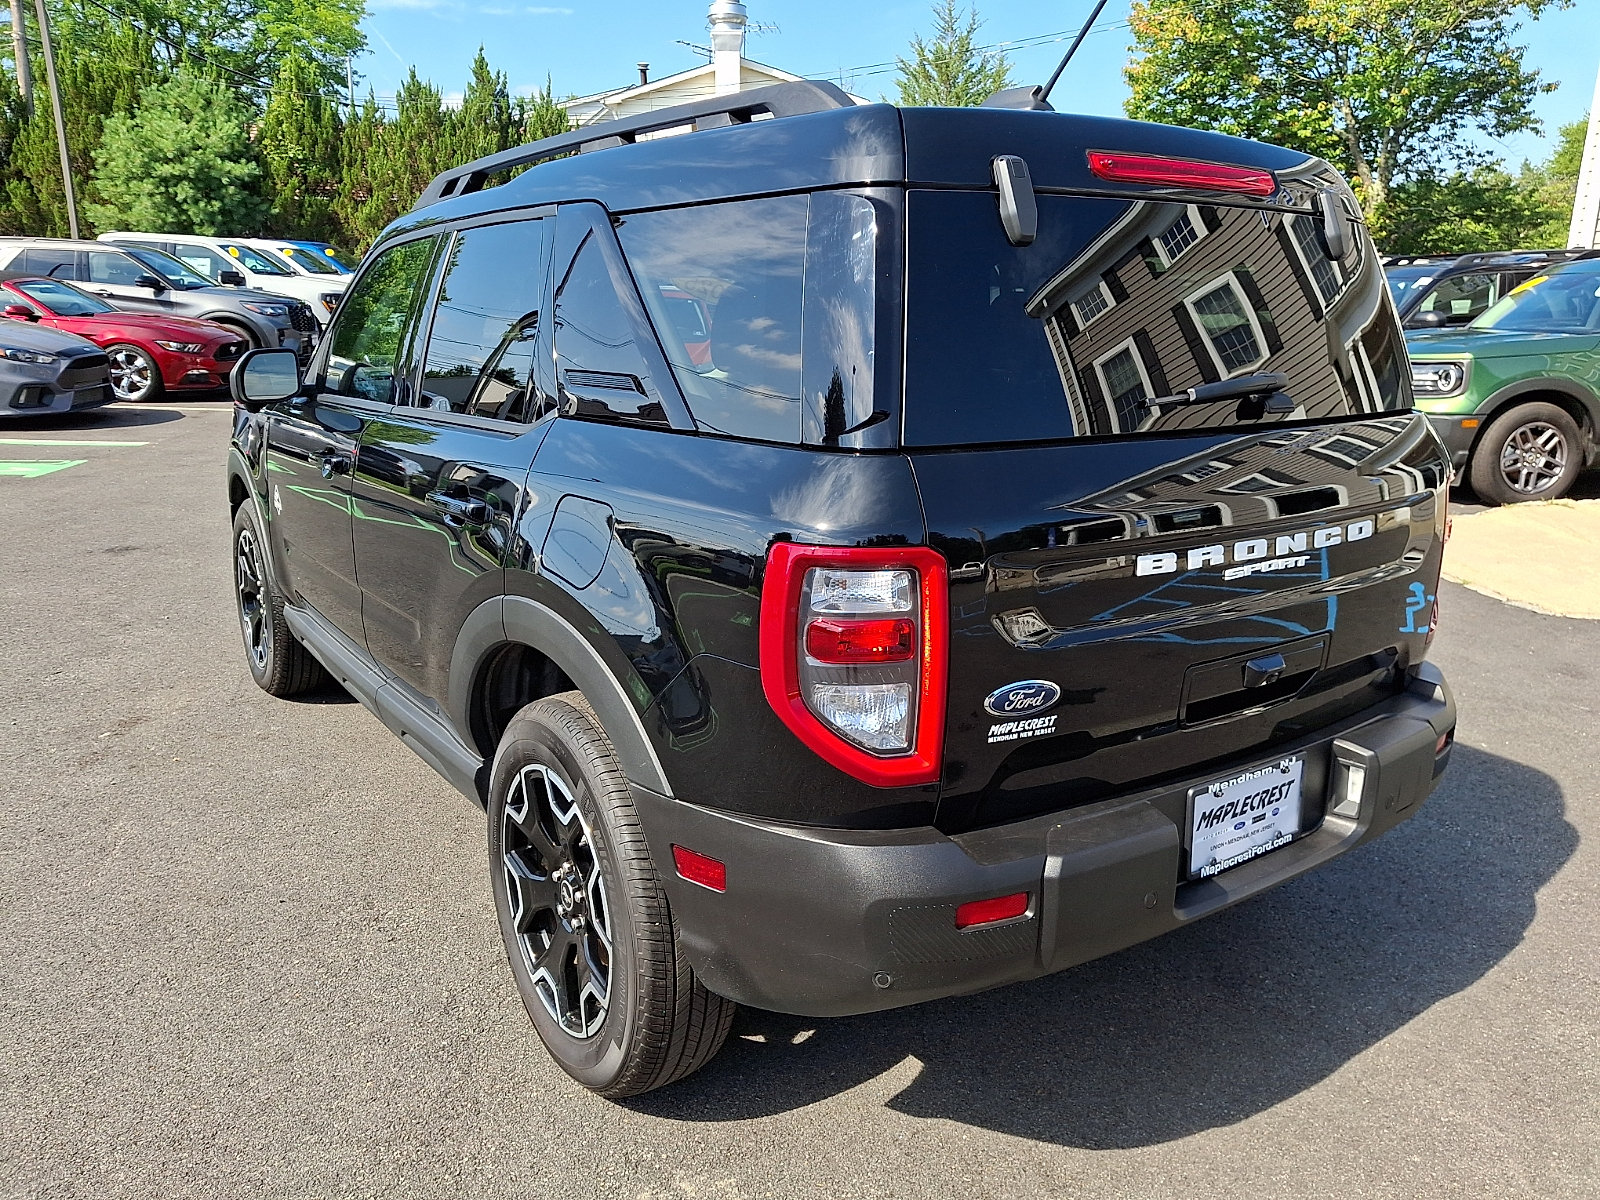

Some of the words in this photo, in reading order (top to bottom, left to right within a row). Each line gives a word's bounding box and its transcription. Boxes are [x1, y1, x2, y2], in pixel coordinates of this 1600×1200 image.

[1136, 519, 1373, 577] BRONCO
[1221, 555, 1310, 581] SPORT
[1004, 688, 1046, 711] Ford
[988, 715, 1058, 736] MAPLECREST
[988, 733, 1018, 743] MENDHAM
[1034, 727, 1056, 736] JERSEY
[1208, 766, 1278, 793] Mendham,
[1279, 756, 1297, 769] NJ
[1196, 779, 1295, 831] MAPLECREST
[1200, 833, 1292, 878] MaplecrestFord.com
